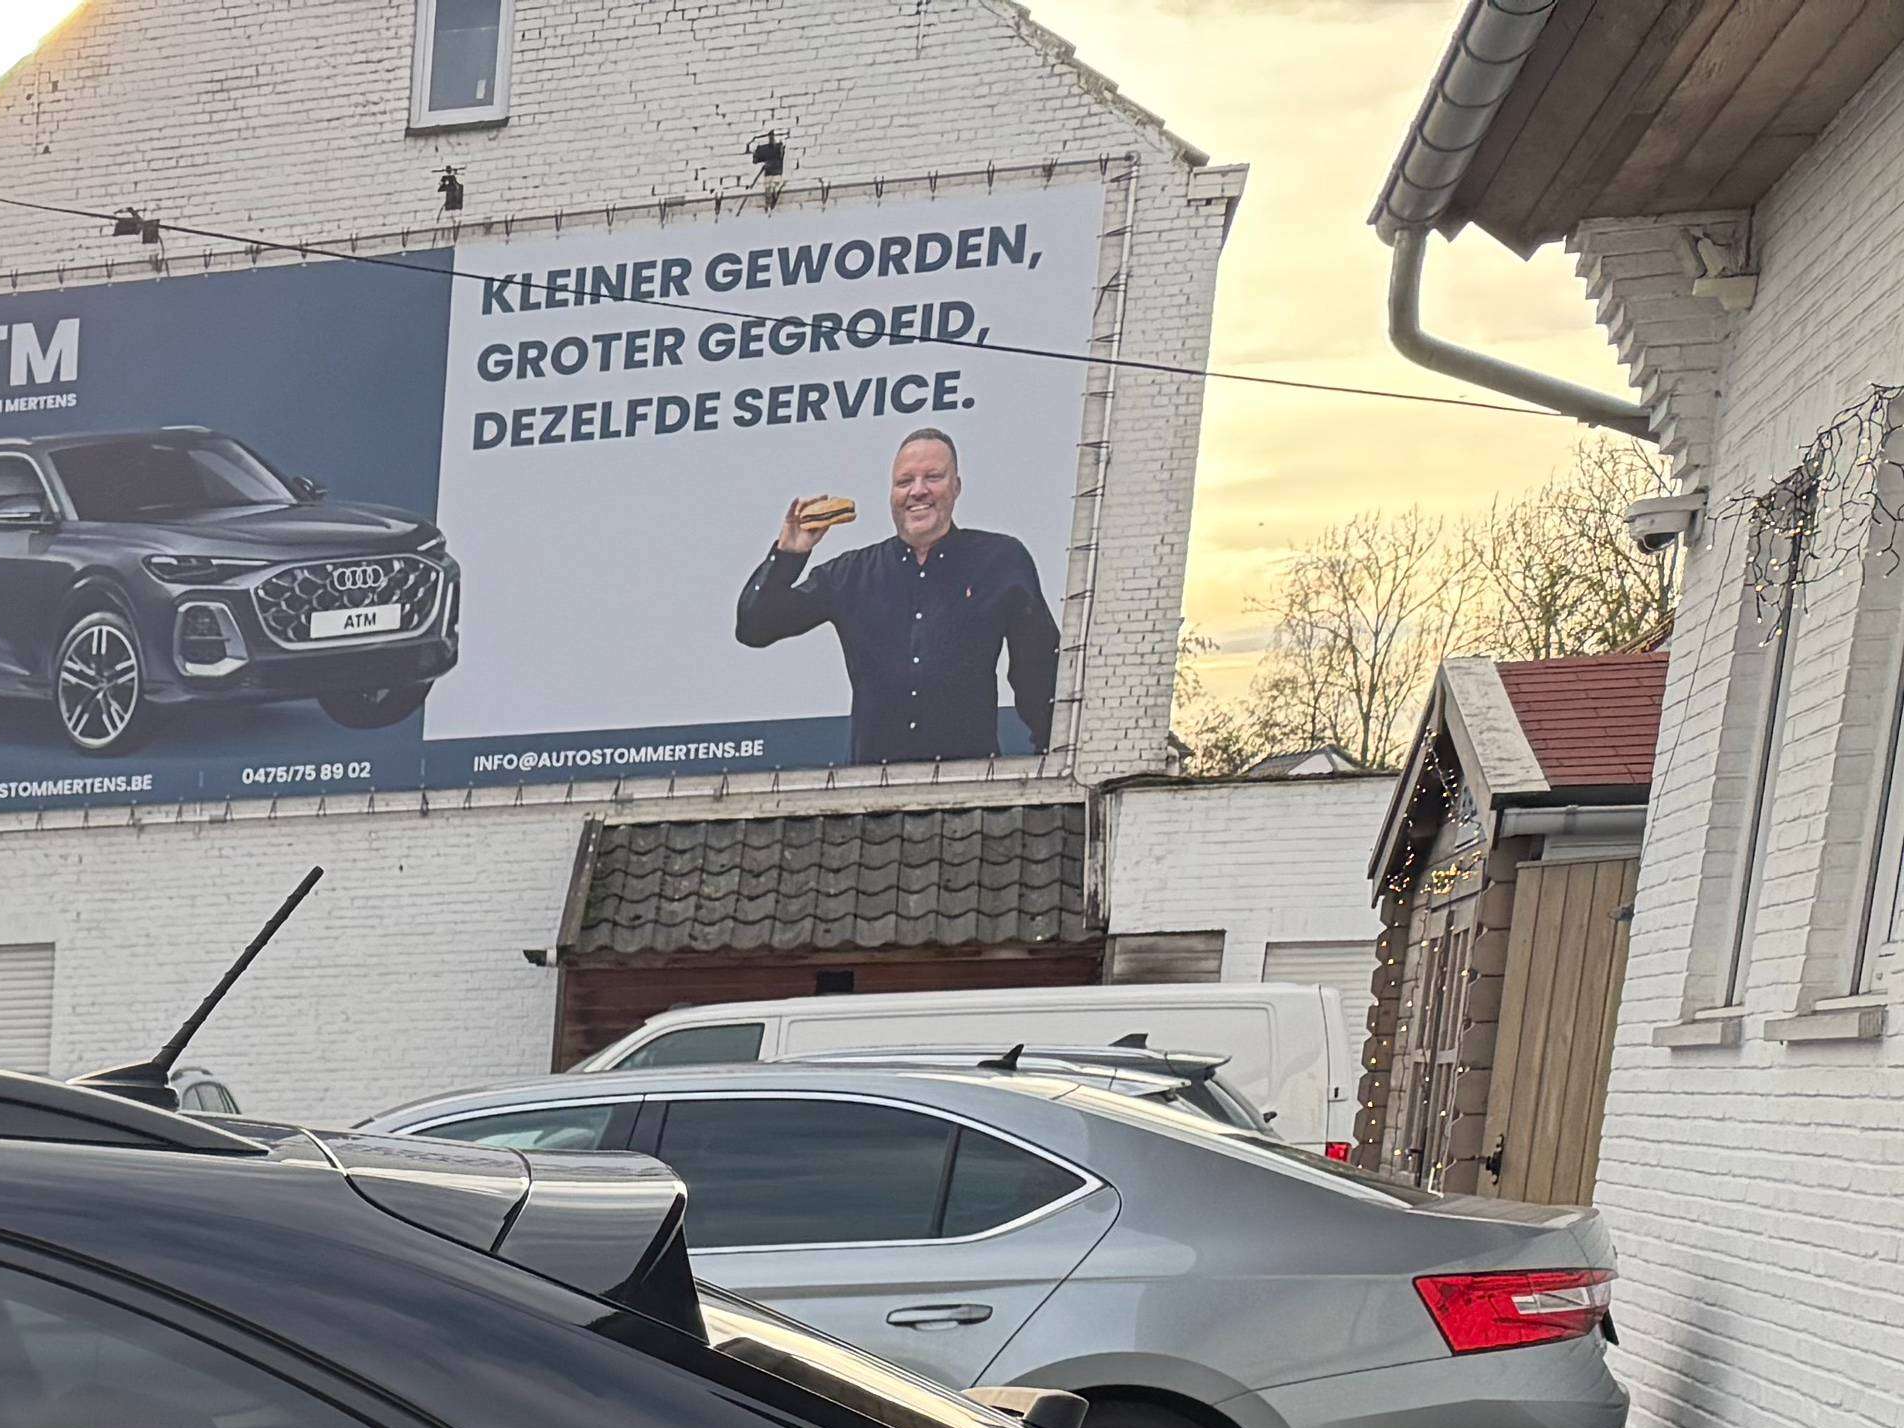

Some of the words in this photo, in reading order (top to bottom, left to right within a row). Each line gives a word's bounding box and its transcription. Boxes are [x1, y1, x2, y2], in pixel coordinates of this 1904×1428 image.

[481, 256, 692, 315] KLEINER
[705, 223, 1043, 293] GEWORDEN,
[476, 326, 686, 382] GROTER
[697, 299, 991, 362] GEGROEID,
[5, 393, 77, 413] MERTENS
[472, 391, 721, 450] DEZELFDE
[733, 370, 975, 428] SERVICE.
[344, 611, 376, 630] ATM
[473, 739, 766, 772] INFO@AUTOSTOMMERTENS.BE
[242, 764, 316, 785] 0475/75
[320, 762, 344, 781] 89
[347, 761, 372, 780] 02
